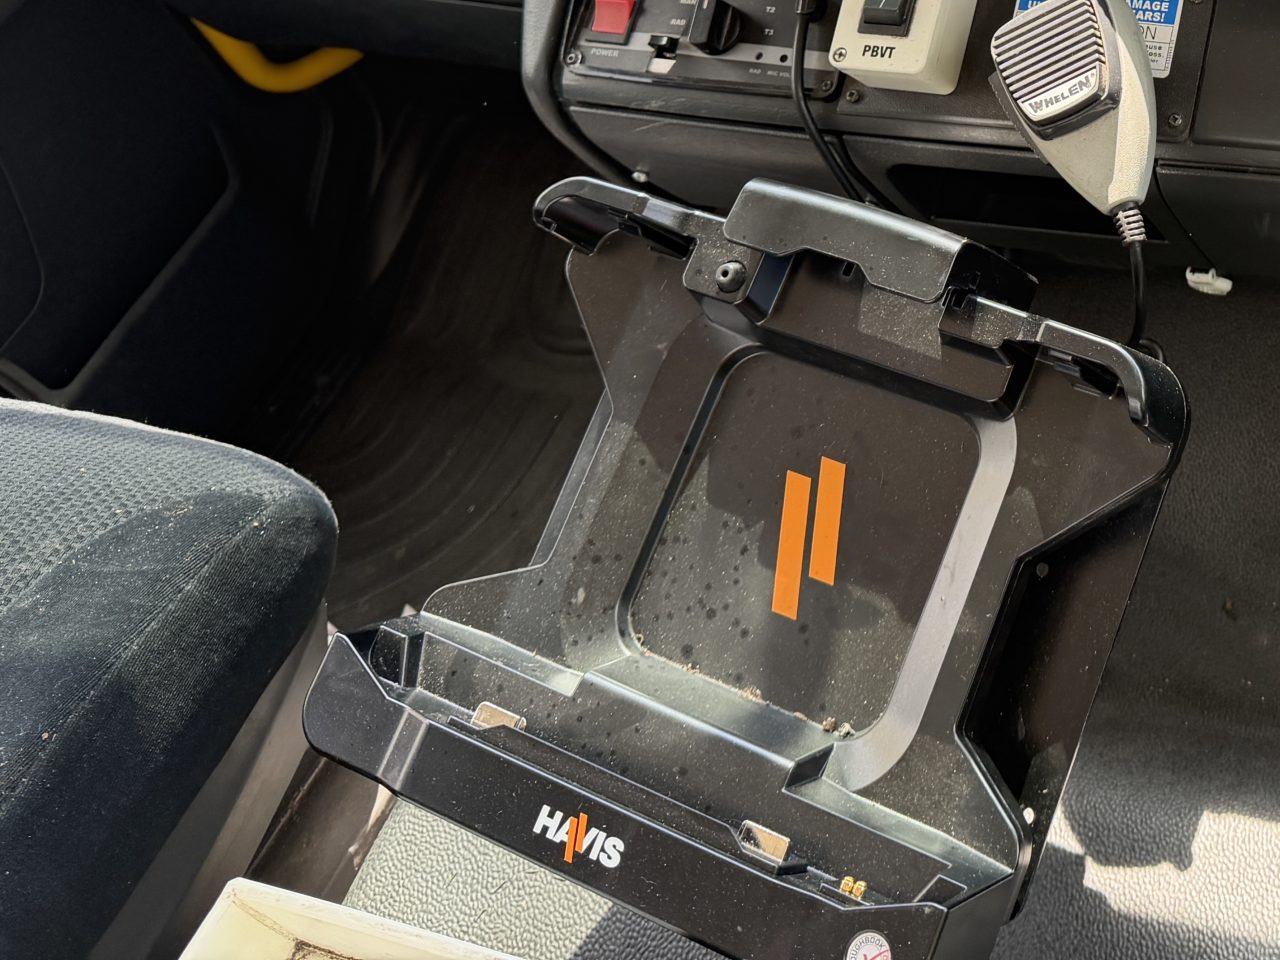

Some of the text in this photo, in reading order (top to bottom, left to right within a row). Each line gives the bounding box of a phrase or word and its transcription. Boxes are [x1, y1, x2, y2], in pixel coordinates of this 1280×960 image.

[1126, 0, 1169, 11] AMAGE
[670, 18, 686, 26] RAD
[1133, 10, 1165, 22] ARS!
[764, 28, 774, 36] T3
[590, 47, 619, 57] POWER
[862, 44, 896, 59] PBVT
[1028, 75, 1092, 113] WHELEN
[532, 804, 625, 868] HAVIS
[851, 936, 885, 960] UGHBOOK
